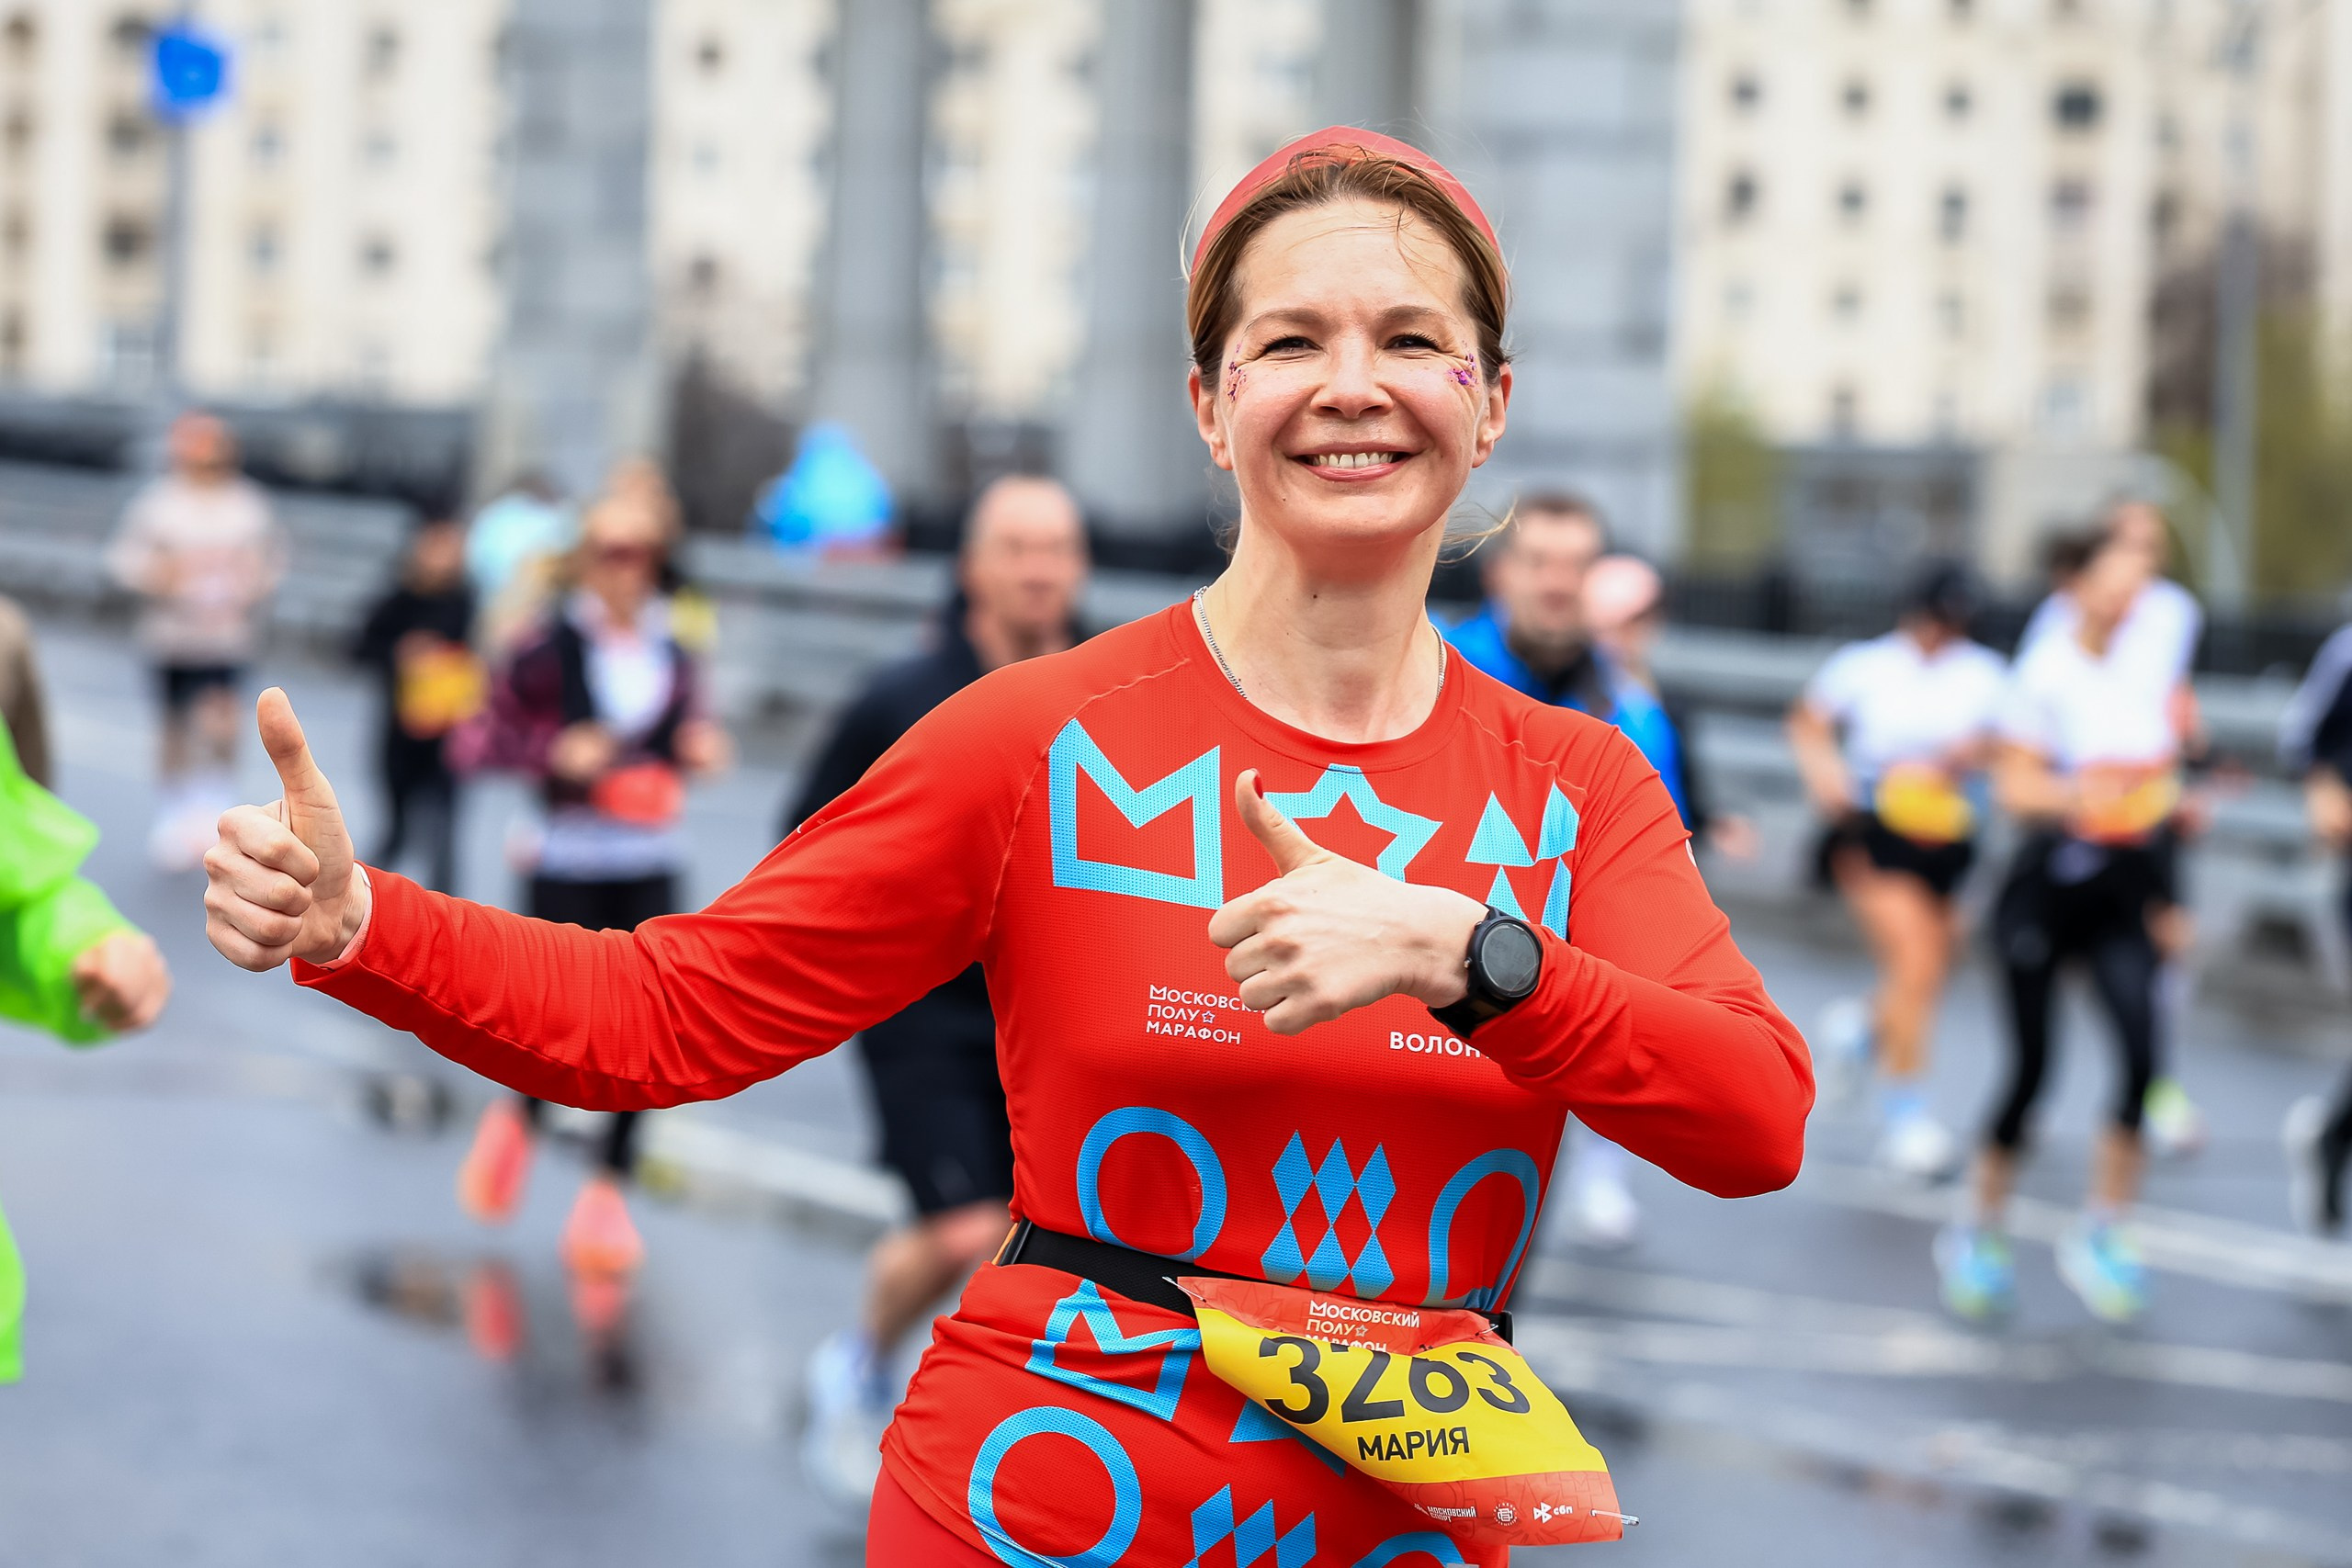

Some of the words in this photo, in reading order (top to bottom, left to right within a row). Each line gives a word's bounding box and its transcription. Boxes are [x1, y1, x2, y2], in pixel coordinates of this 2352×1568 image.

[1148, 1004, 1200, 1021] ПОЛУ
[1146, 1021, 1241, 1044] МАРАФОН
[1389, 1031, 1489, 1058] ВОЛОН
[1306, 1319, 1356, 1336] ПОЛУ
[1259, 1336, 1531, 1425] 3263
[1357, 1427, 1470, 1461] МАРИЯ
